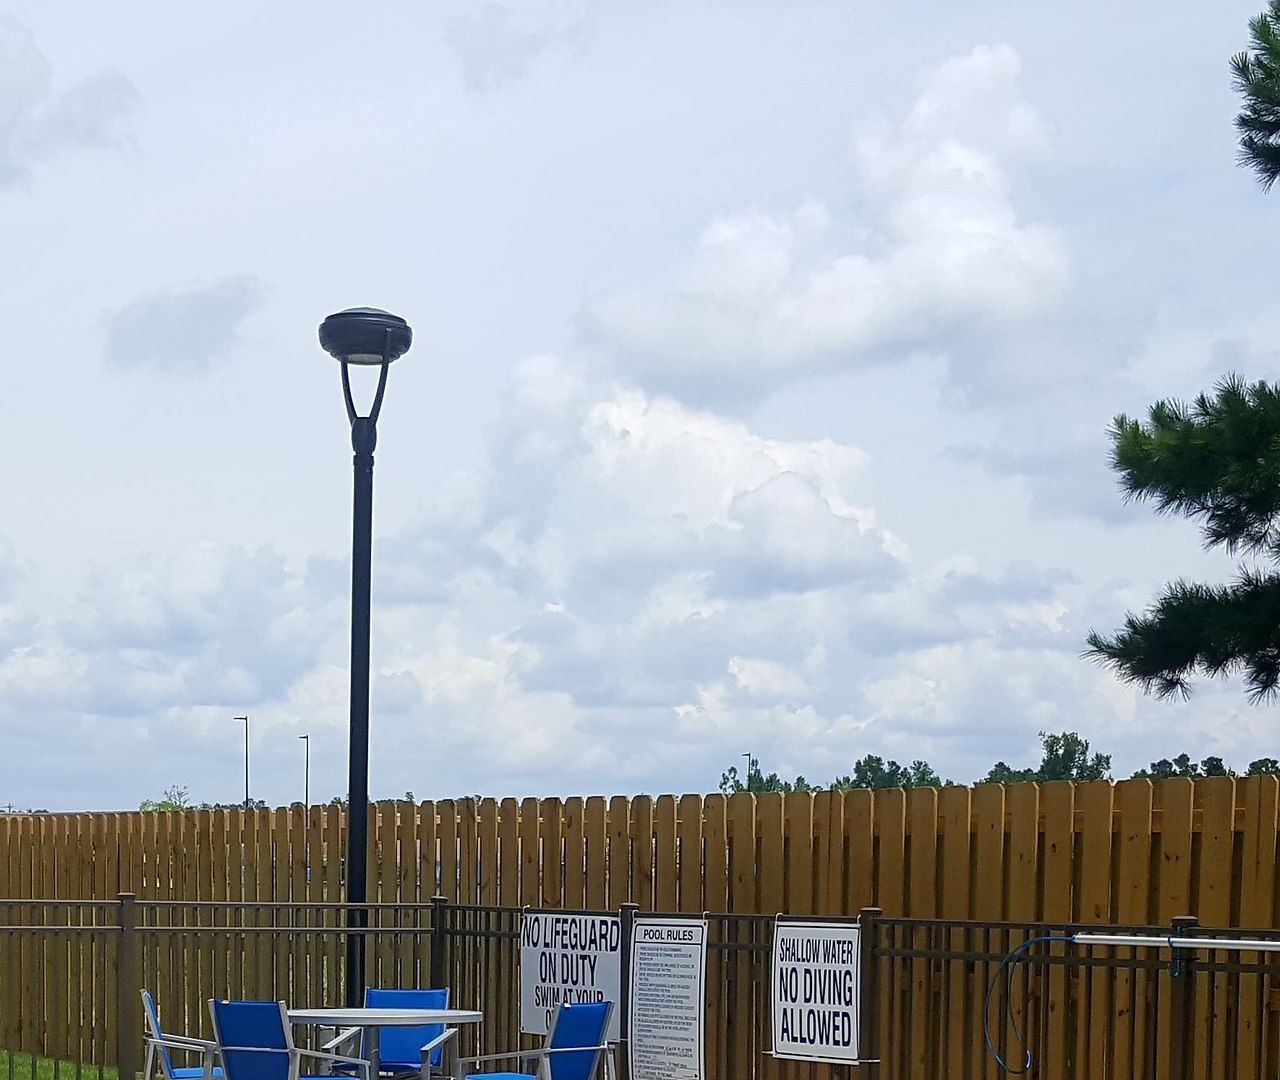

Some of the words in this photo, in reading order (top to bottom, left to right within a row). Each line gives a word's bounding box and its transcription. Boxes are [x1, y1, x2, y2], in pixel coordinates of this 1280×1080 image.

[522, 916, 540, 948] NO
[543, 917, 620, 952] LIFEGUARD
[643, 929, 665, 940] POOL
[666, 930, 694, 941] RULES
[780, 938, 820, 963] SHALLOW
[822, 940, 853, 964] WATER
[539, 951, 557, 983] ON
[561, 953, 597, 986] DUTY
[534, 985, 560, 1008] SWIM
[563, 987, 574, 1004] AT
[780, 967, 798, 1003] NO
[803, 968, 853, 1007] DIVING
[781, 1008, 851, 1047] ALLOWED
